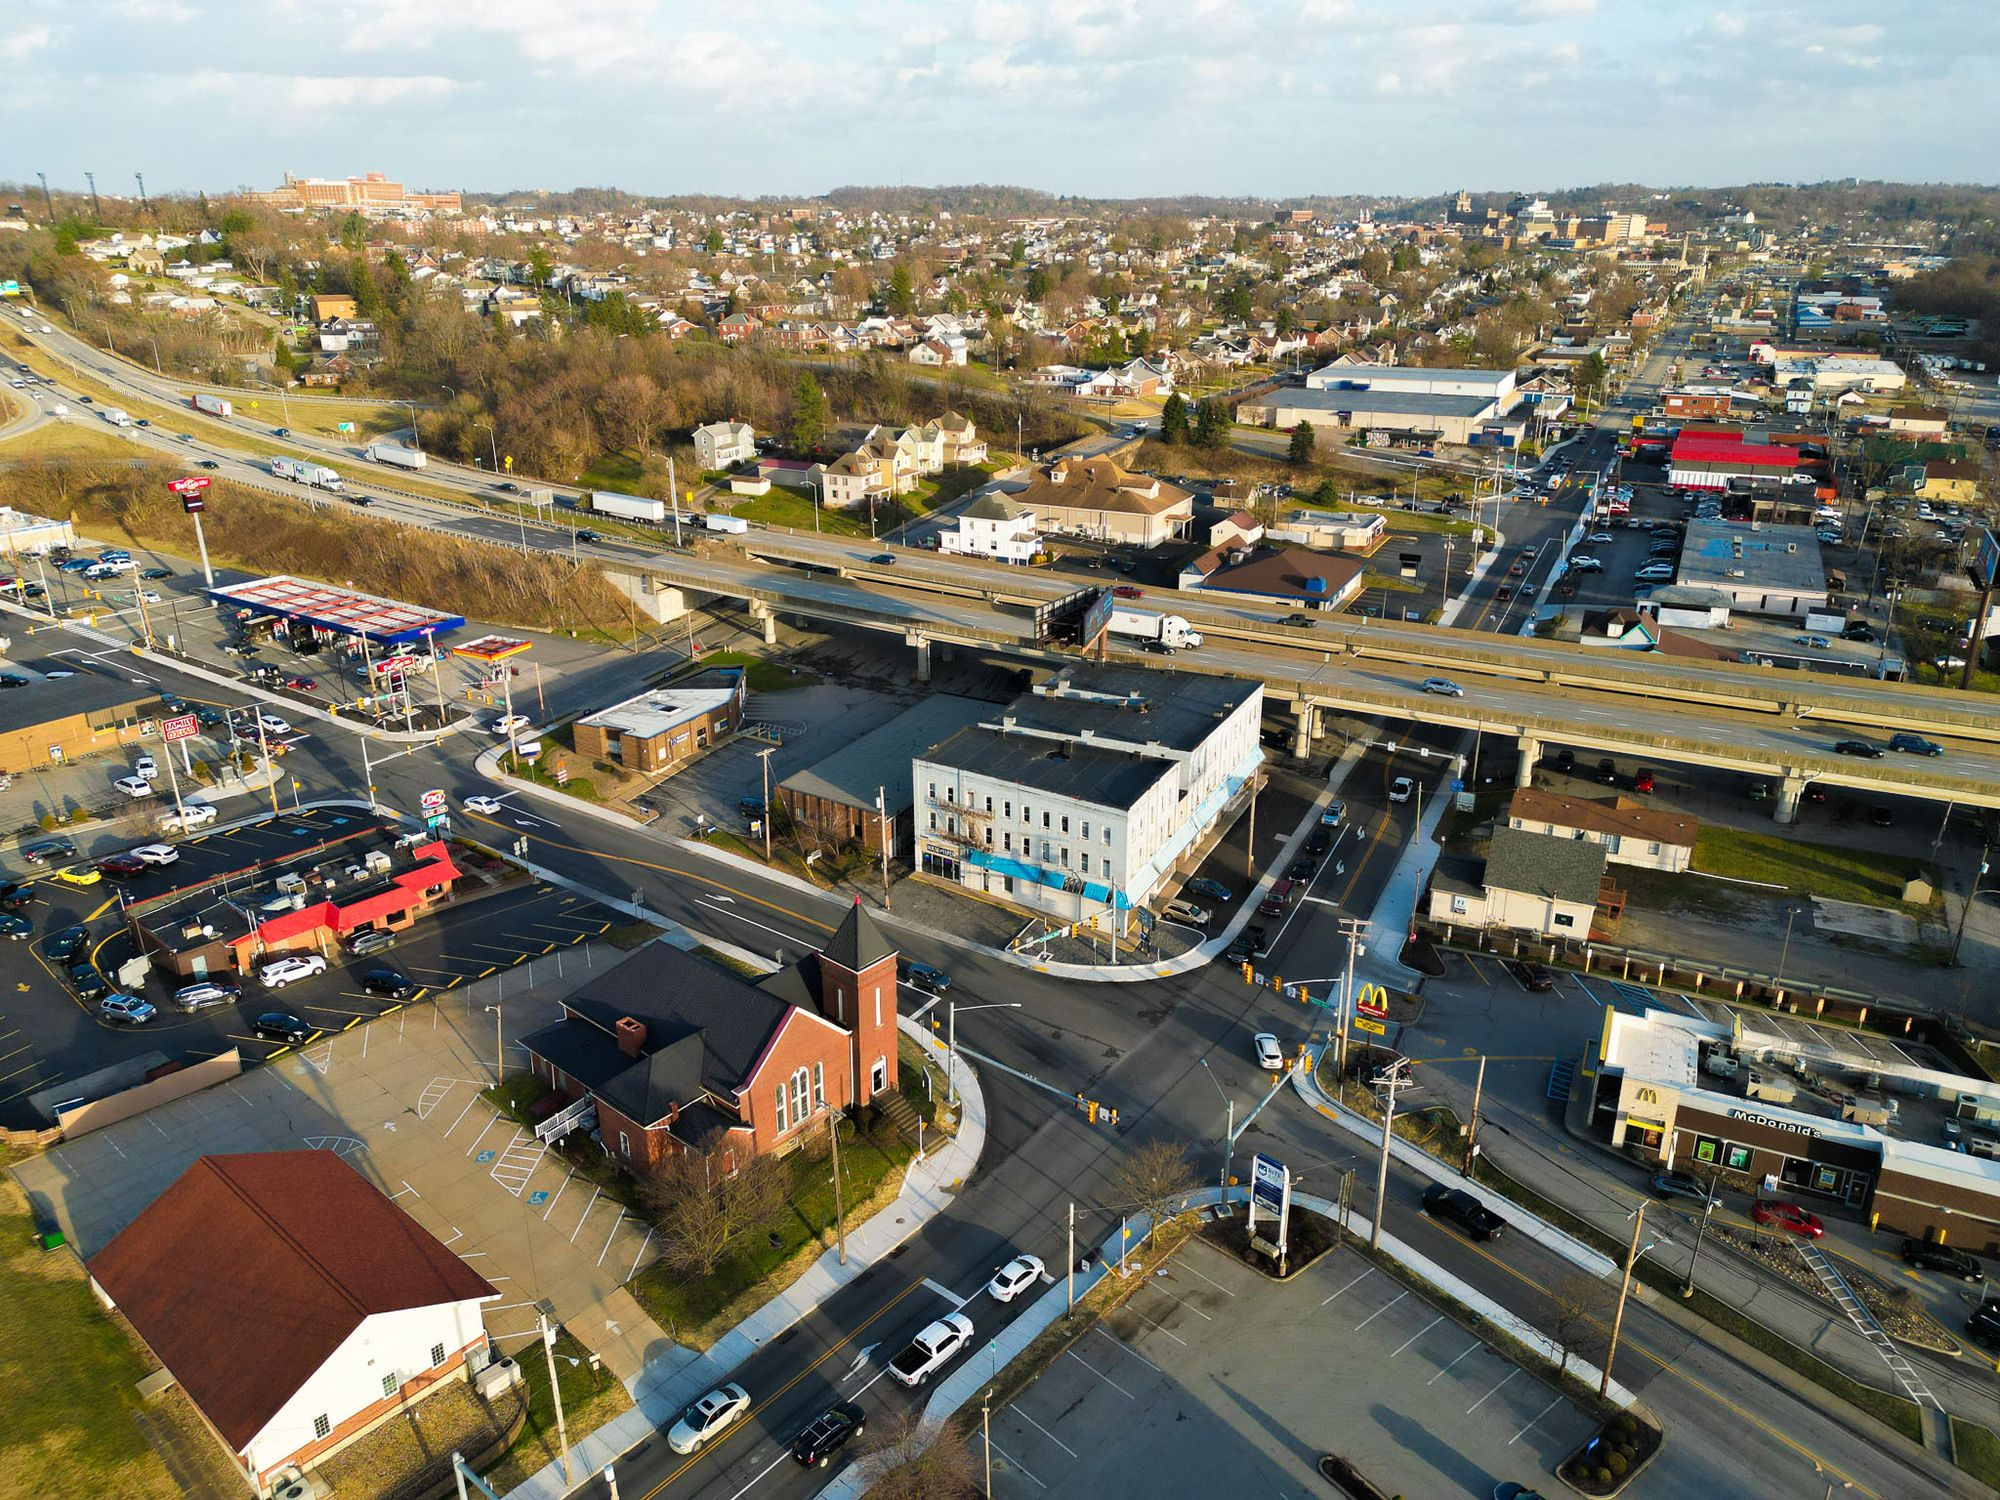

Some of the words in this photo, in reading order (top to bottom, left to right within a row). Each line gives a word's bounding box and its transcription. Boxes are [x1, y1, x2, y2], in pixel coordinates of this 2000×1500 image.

[166, 717, 193, 731] FAMILY
[167, 726, 195, 739] DOLLAR
[1732, 1109, 1822, 1140] McDonald's
[1268, 1167, 1281, 1178] RITE
